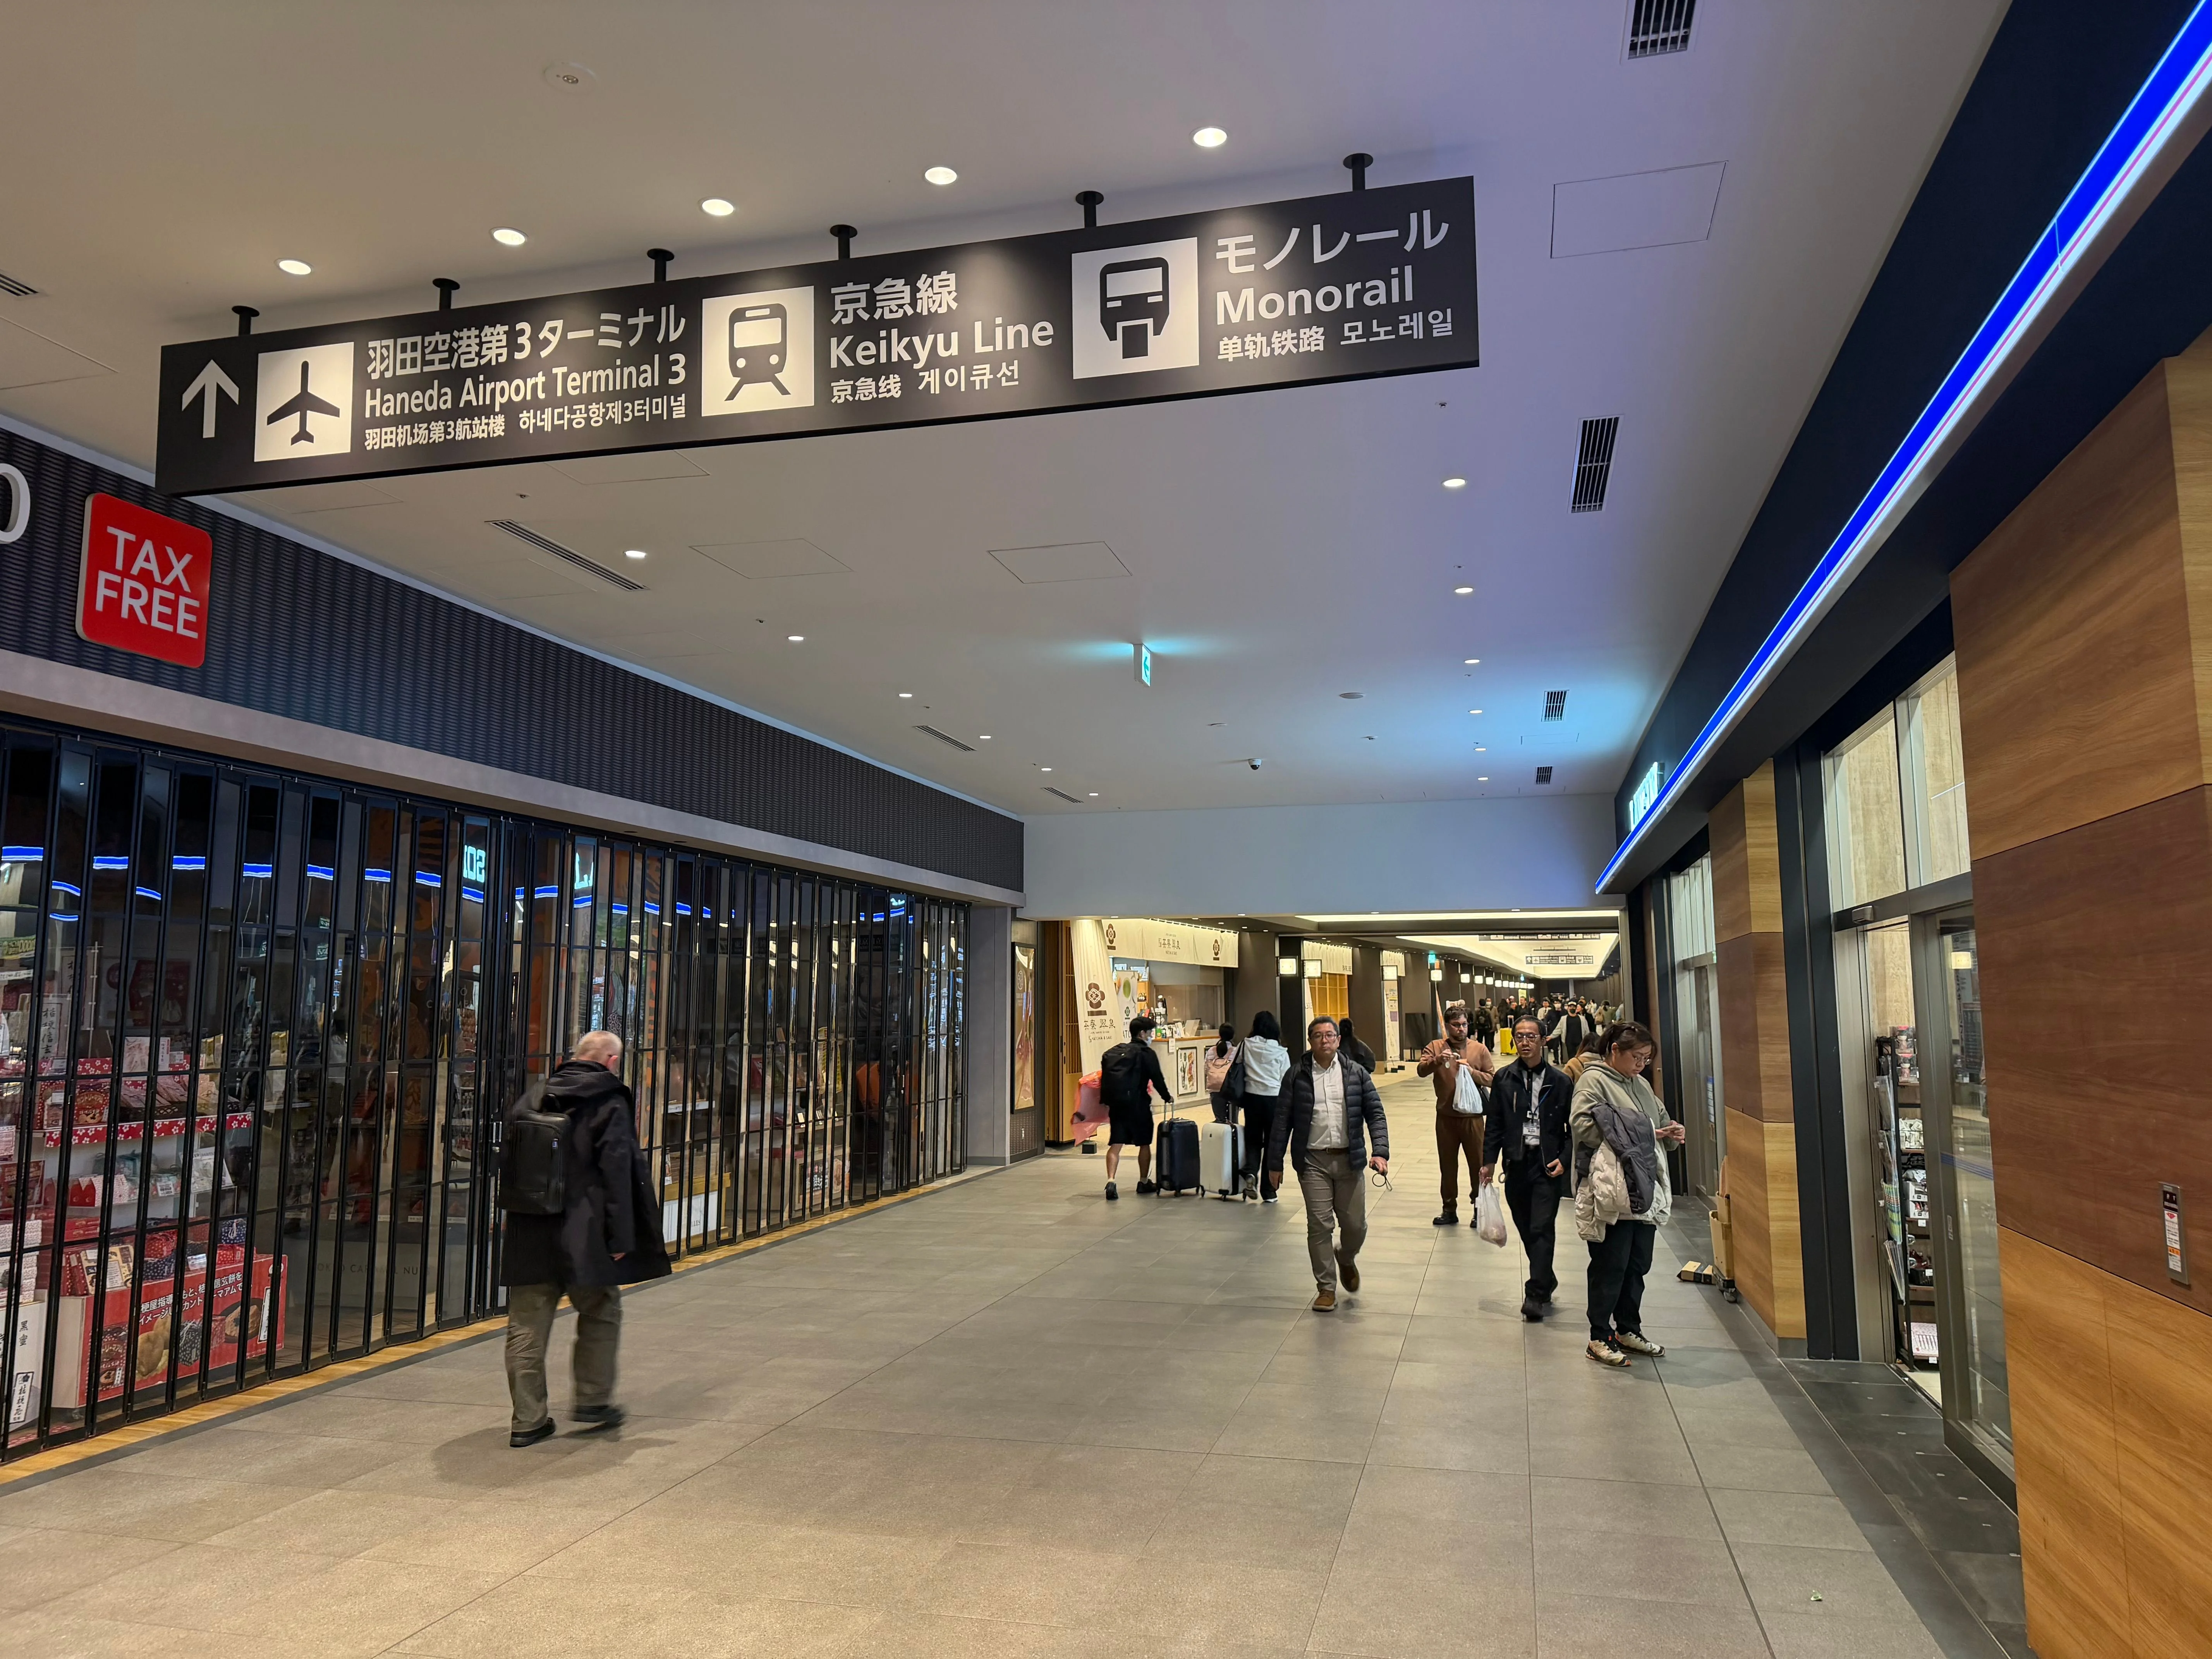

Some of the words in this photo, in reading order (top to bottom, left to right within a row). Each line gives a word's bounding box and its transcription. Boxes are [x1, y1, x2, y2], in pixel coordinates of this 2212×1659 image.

[1216, 210, 1449, 274] モノレール
[831, 271, 958, 325] 京急線
[1217, 265, 1412, 325] Monorail
[831, 328, 958, 369] Keikyu
[974, 317, 1054, 353] Line
[1218, 326, 1325, 362] 单轨铁路
[1340, 308, 1453, 345] 모노레일
[365, 380, 452, 418] Haneda
[459, 371, 546, 412] Airport
[552, 354, 659, 397] Terminal
[668, 353, 685, 385] 3
[831, 374, 902, 404] 京急线
[918, 360, 1019, 394] 게이큐선
[365, 414, 505, 450] 羽田机场第3航站楼
[519, 393, 685, 434] 하네다공항제3터미널
[106, 526, 193, 593] TAX
[95, 570, 201, 639] FREE
[41, 1008, 56, 1060] 桔梗信玄
